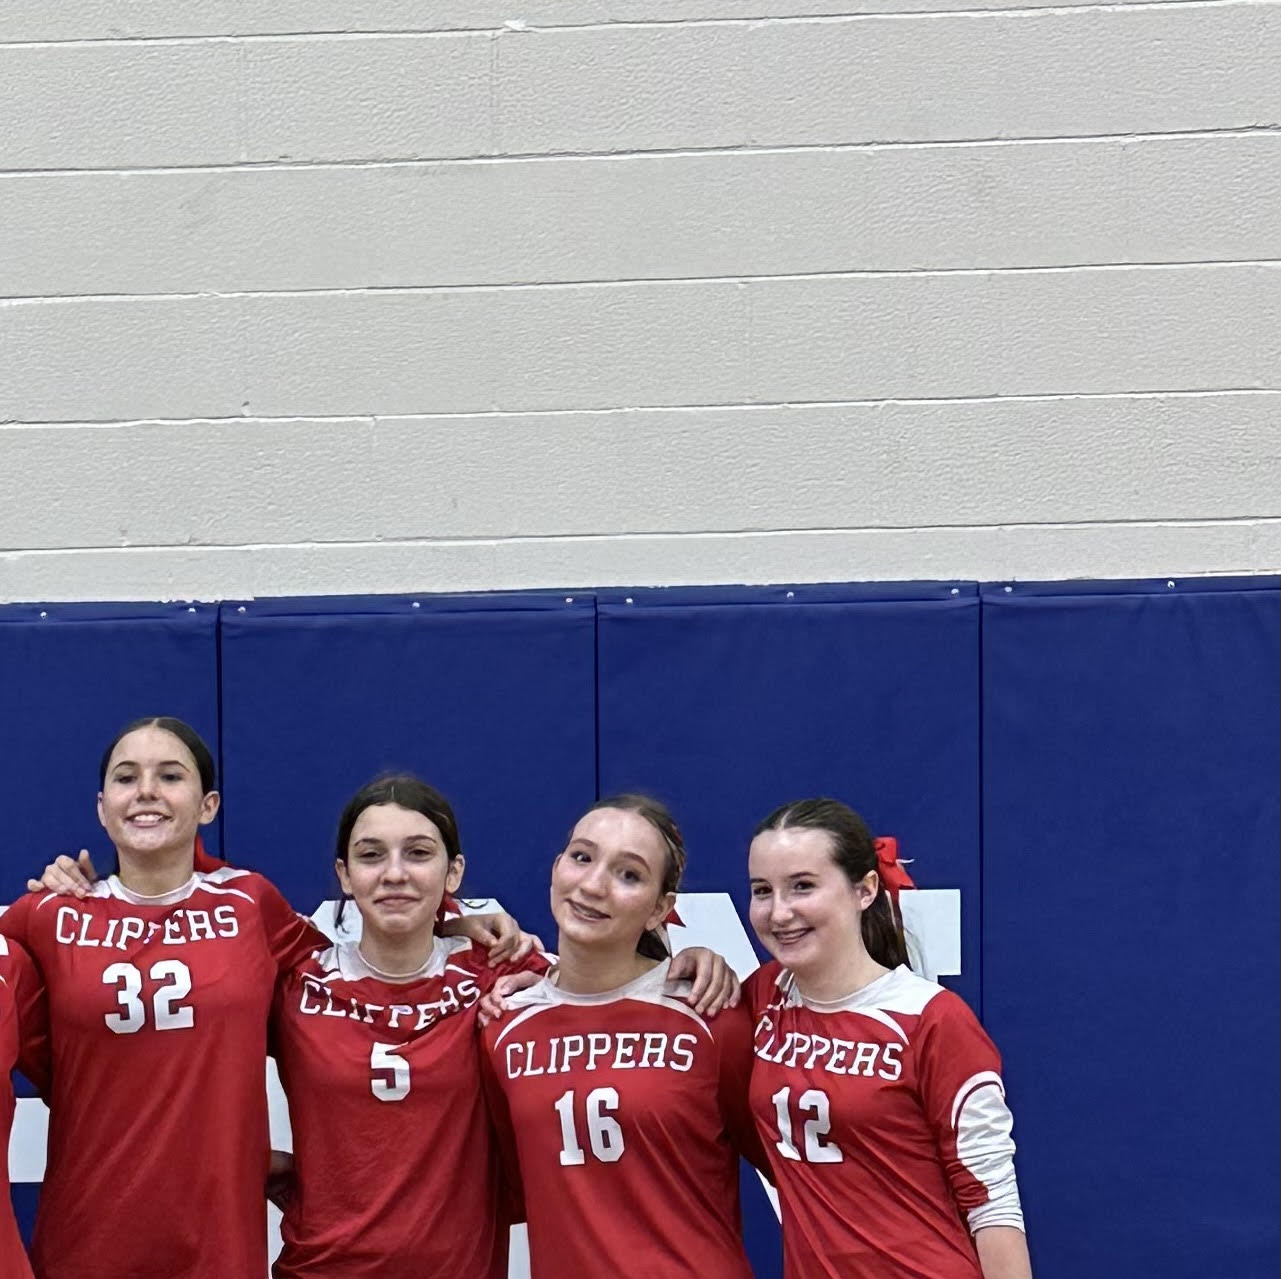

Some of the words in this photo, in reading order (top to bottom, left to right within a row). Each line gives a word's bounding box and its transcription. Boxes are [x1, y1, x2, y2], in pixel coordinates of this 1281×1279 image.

[102, 959, 194, 1034] 32
[371, 1042, 411, 1101] 5
[506, 1033, 698, 1079] CLIPPERS
[554, 1087, 625, 1166] 16
[772, 1086, 843, 1163] 12
